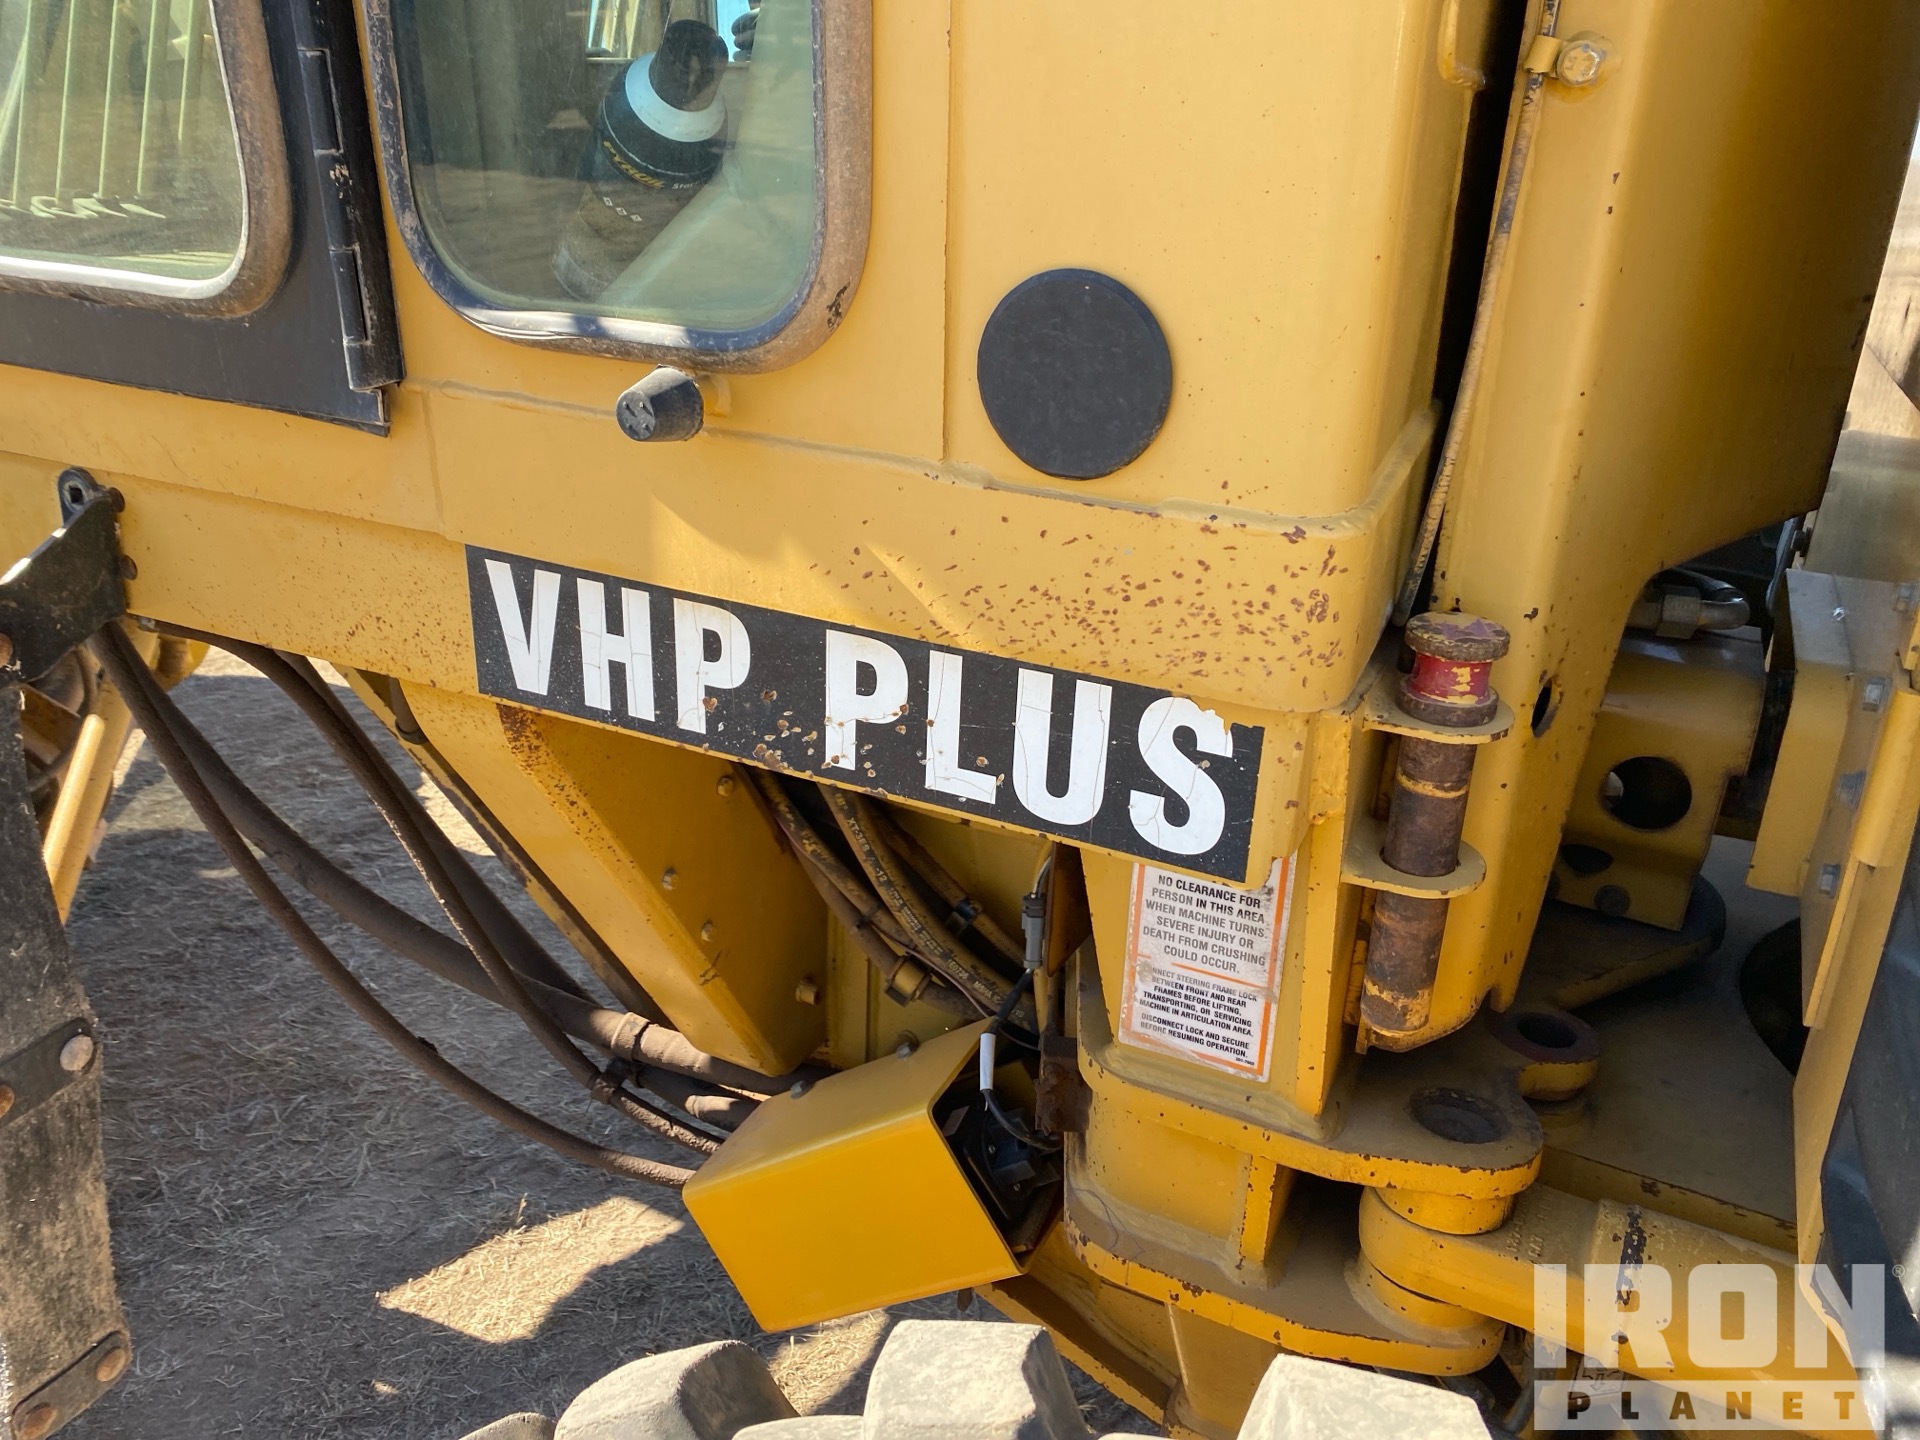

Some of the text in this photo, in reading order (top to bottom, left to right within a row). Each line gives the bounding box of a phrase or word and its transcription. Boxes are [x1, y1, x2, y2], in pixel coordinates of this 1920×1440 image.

[484, 557, 1235, 857] VHP PLUS
[1152, 887, 1193, 906] PERSON
[1196, 898, 1207, 909] IN
[1210, 901, 1234, 915] THIS
[1158, 874, 1261, 909] NO CLEARANCE FOR
[1145, 898, 1269, 939] WHEN MACHINE TURNS.
[1156, 916, 1254, 950] SEVERE INJURY OR
[1142, 925, 1266, 967] DEATH FROM CRUSHING
[1163, 945, 1240, 974] COULD OCCUR.
[1152, 976, 1246, 1008] BETWEEN FRONT AND REAR
[1154, 985, 1182, 999] FRAMES
[1183, 994, 1211, 1007] BEFORE
[1176, 974, 1211, 989] STEERING
[1212, 983, 1237, 996] FRAME
[1238, 991, 1258, 1002] LOCK
[1139, 998, 1170, 1013] MACHINE
[1171, 1007, 1179, 1016] IN
[1180, 1010, 1231, 1031] ARTICULATION
[1141, 1012, 1250, 1050] DISCONNECT LOCK AND SECURE
[1200, 1007, 1211, 1016] OR
[1213, 1011, 1252, 1028] SERVICING
[1140, 1021, 1248, 1058] BEFORE RESUMING OPERATION.
